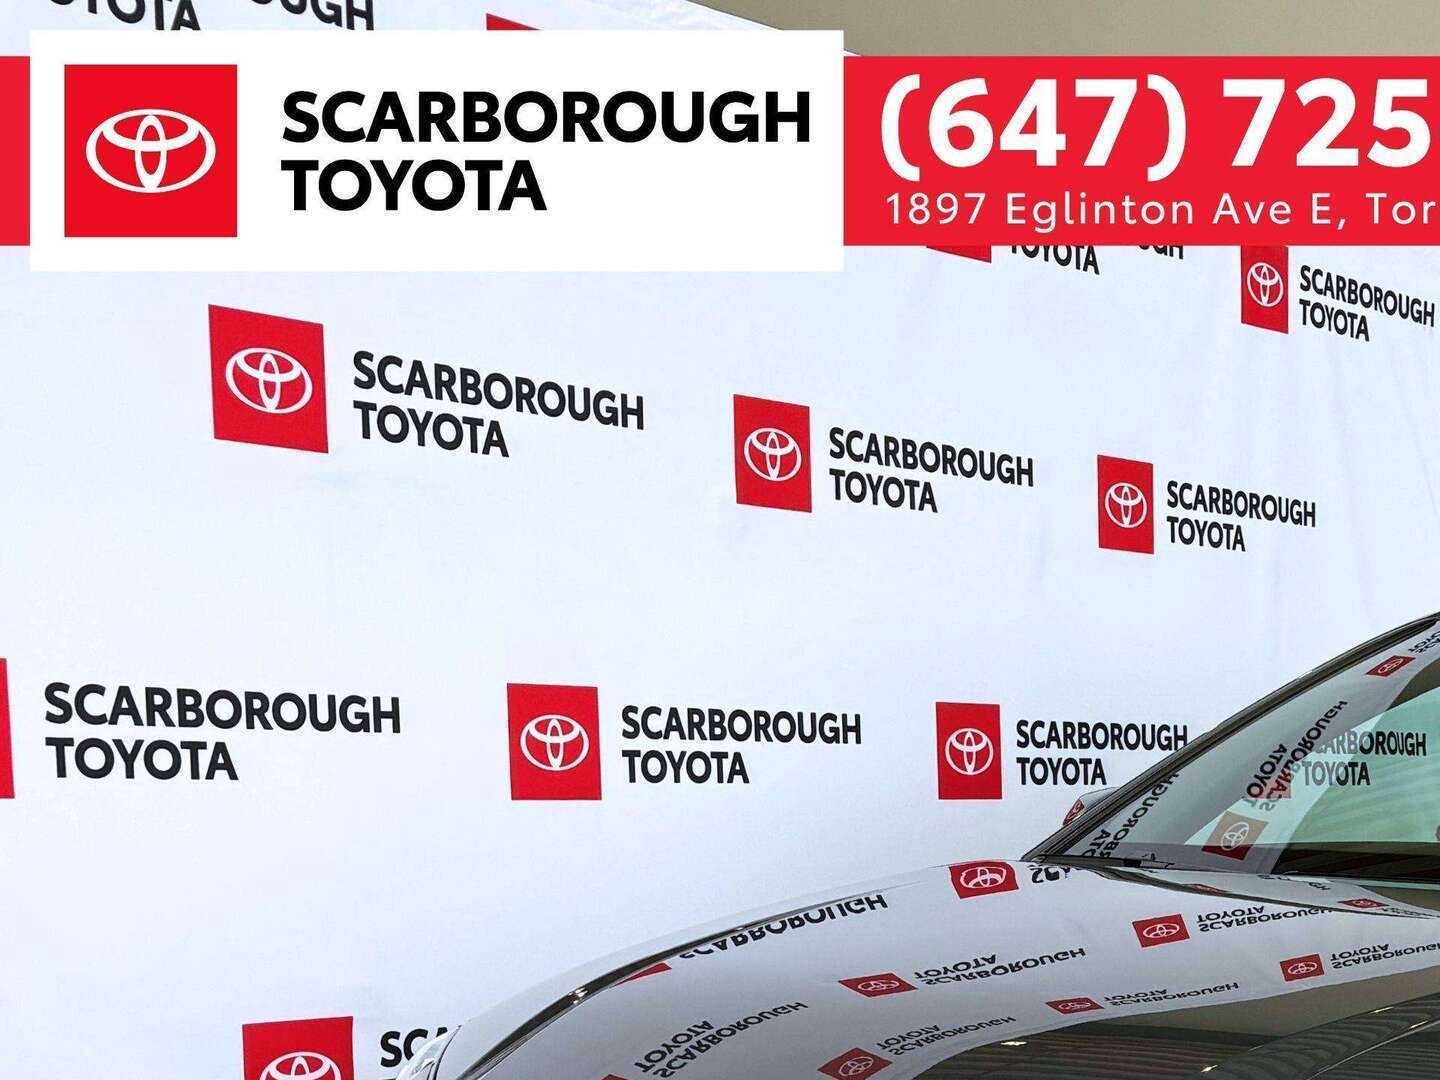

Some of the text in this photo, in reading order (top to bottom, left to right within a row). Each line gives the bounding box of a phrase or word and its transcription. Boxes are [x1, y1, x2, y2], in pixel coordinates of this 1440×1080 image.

[1300, 264, 1435, 327] SCARBOROUGH
[1300, 299, 1370, 341] TOYOTA
[352, 350, 644, 431] SCARBOROUGH
[352, 401, 509, 459] TOYOTA
[829, 426, 1034, 487] SCARBOROUGH
[829, 467, 938, 513] TOYOTA
[1166, 480, 1317, 528] SCARBOROUGH
[1166, 515, 1246, 552] TOYOTA
[44, 682, 401, 734] SCARBOROUGH
[621, 705, 862, 745] SCARBOROUGH
[1016, 718, 1188, 751] SCARBOROUGH
[44, 736, 239, 781] TOYOTA
[621, 749, 750, 784] TOYOTA
[1016, 757, 1107, 786] TOYOTA
[1302, 761, 1371, 786] TOYOTA
